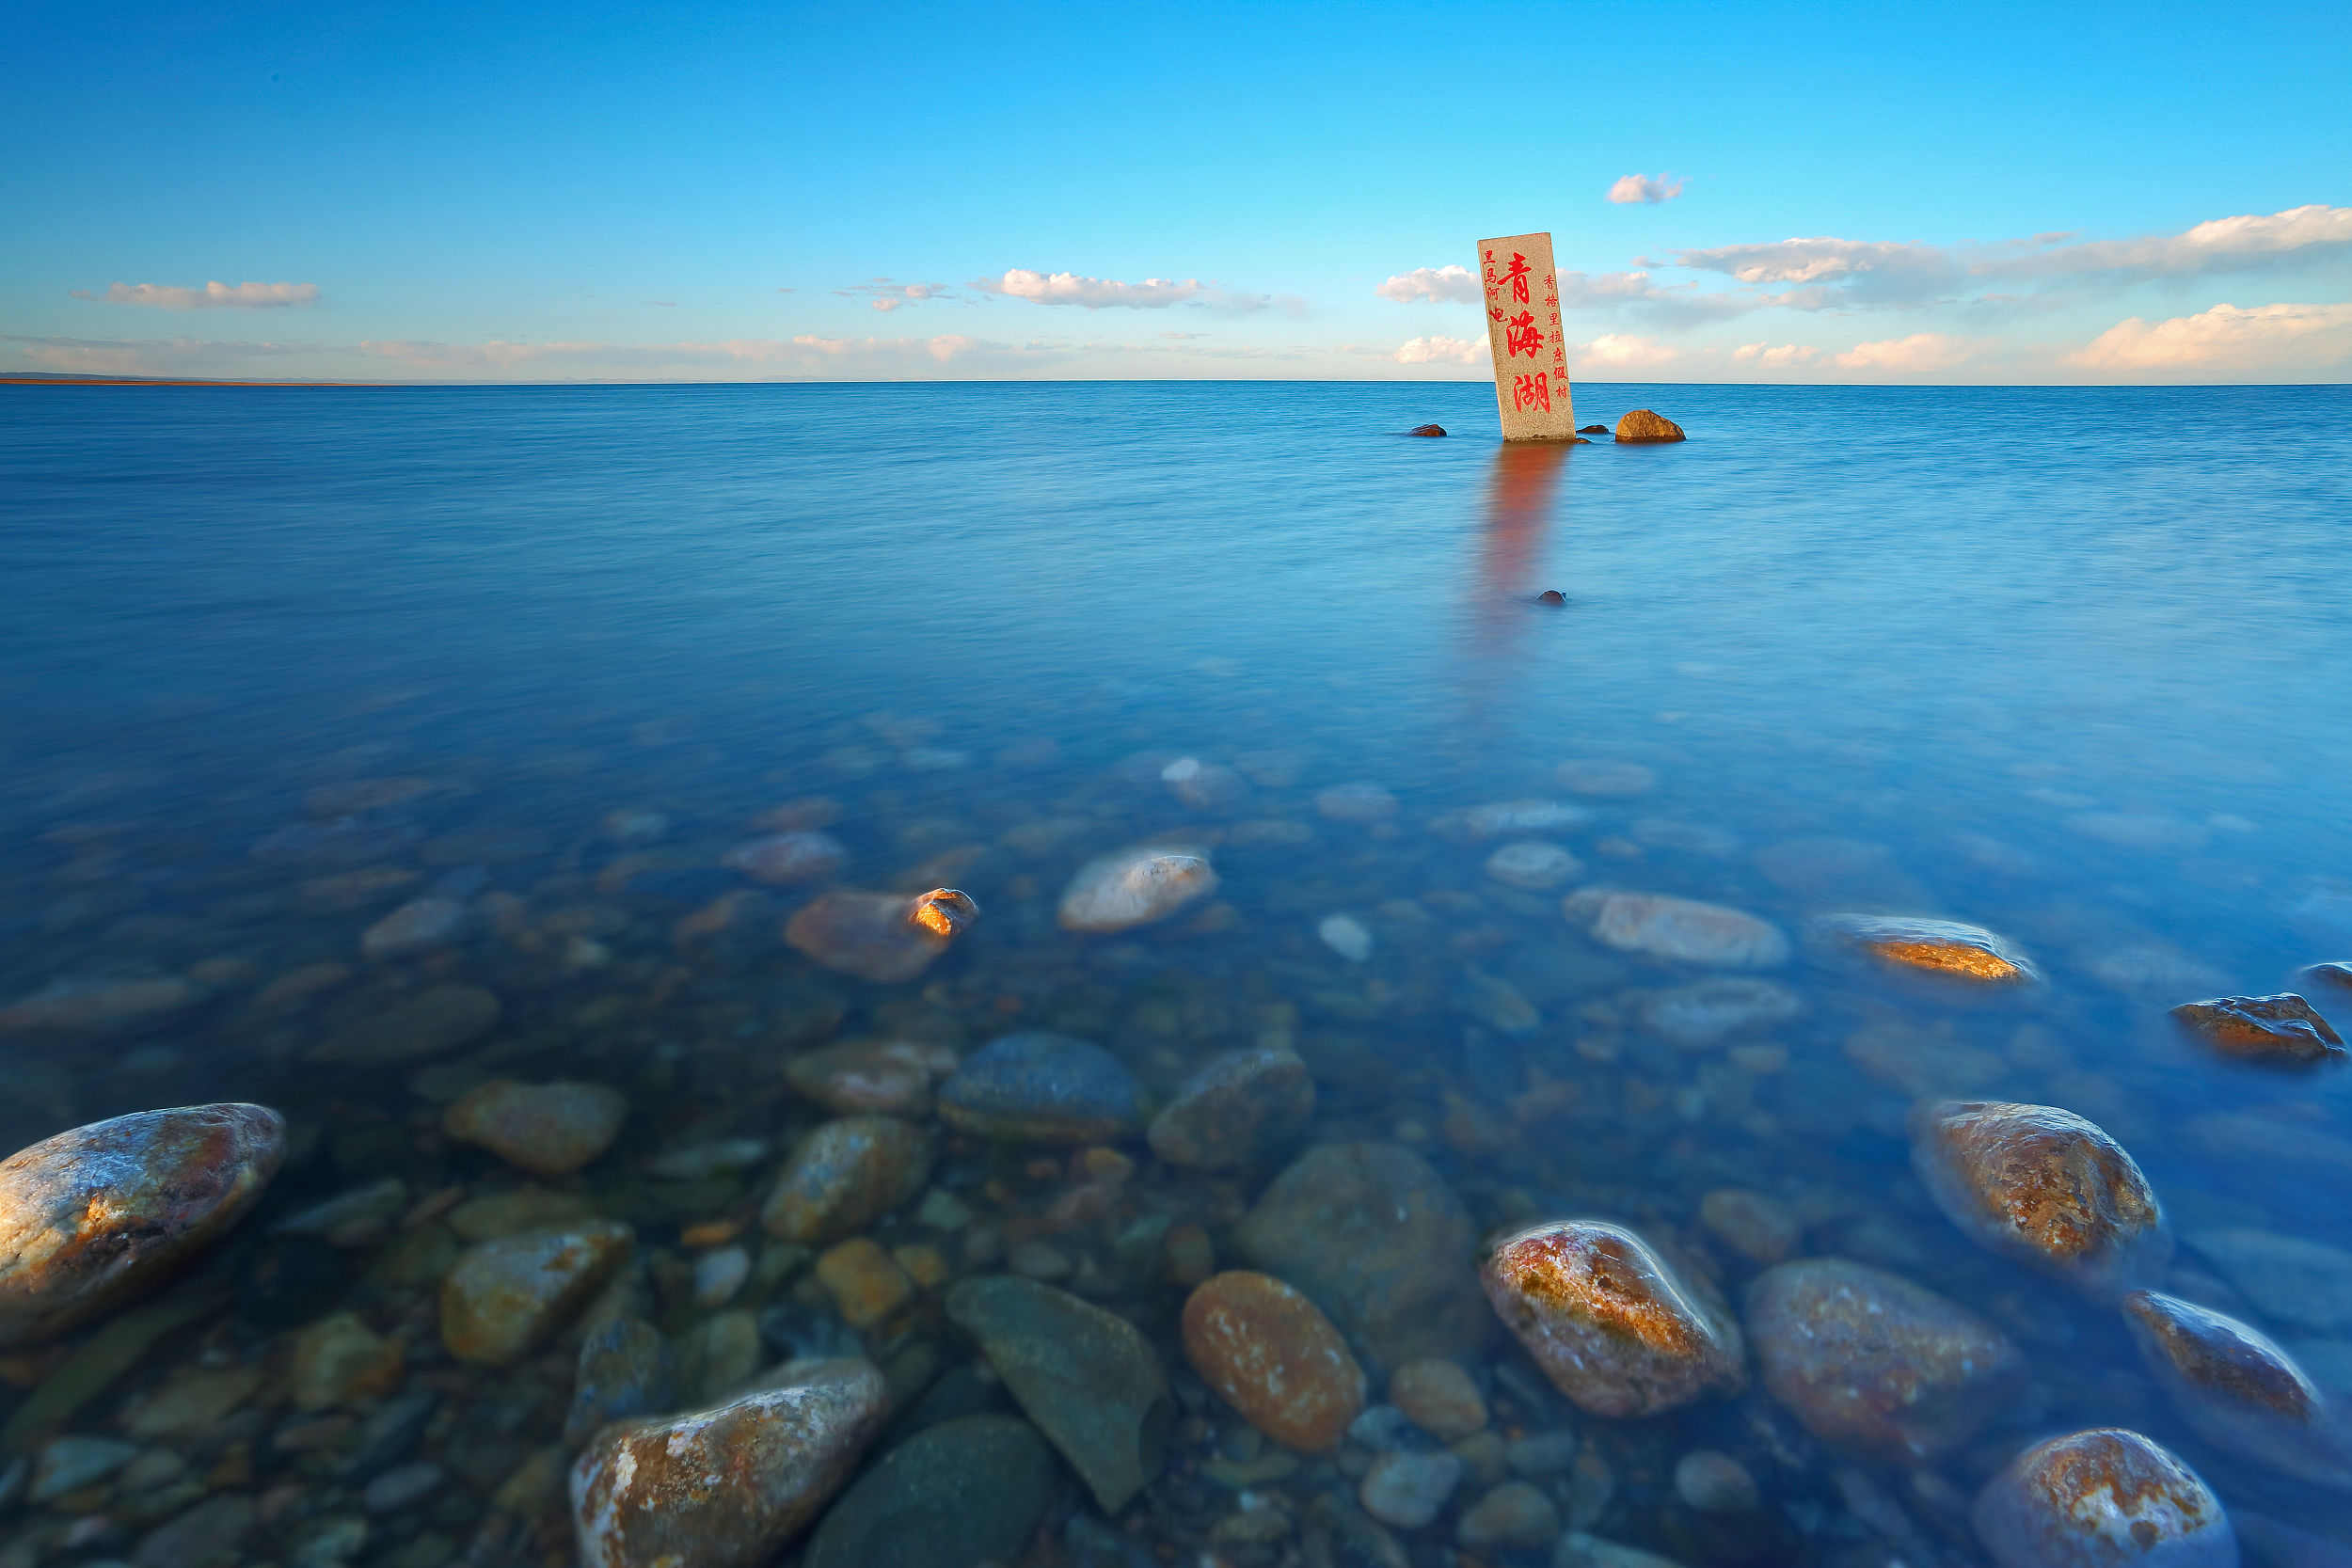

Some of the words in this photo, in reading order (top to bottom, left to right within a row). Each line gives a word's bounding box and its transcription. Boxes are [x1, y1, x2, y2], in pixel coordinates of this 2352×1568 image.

[1497, 251, 1551, 415] 青海湖
[1543, 274, 1568, 400] 香格里拉度假村
